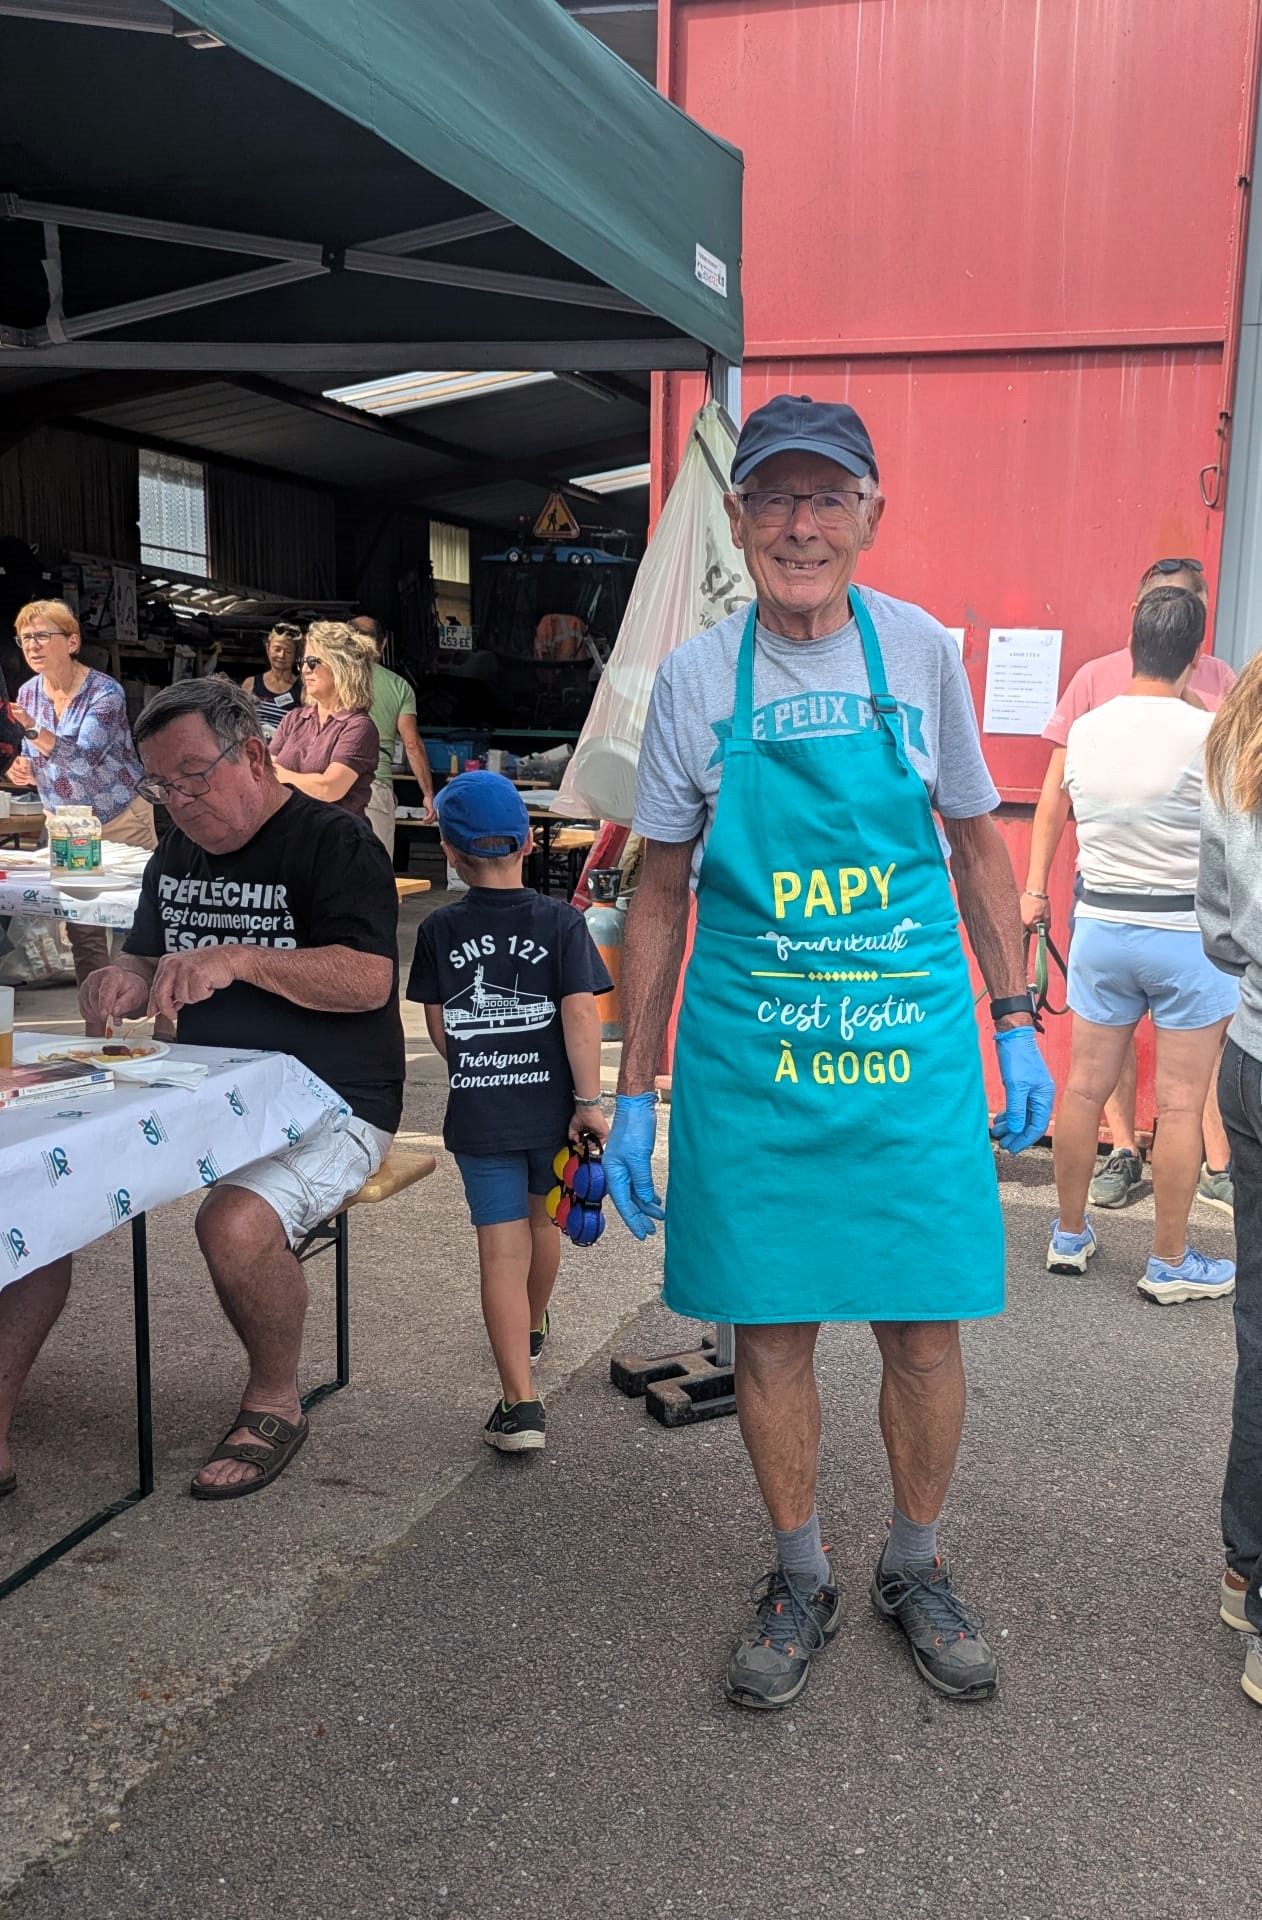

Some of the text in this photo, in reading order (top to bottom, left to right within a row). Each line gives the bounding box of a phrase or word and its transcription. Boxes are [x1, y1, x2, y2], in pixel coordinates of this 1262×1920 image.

[753, 712, 767, 740] E
[774, 696, 849, 734] PEUX
[158, 871, 288, 910] RÉFLÉCHIR
[772, 862, 896, 919] PAPY
[160, 901, 295, 931] 'est commencer à
[449, 934, 549, 969] SNS 127
[757, 994, 926, 1041] c'est festin
[450, 1070, 550, 1089] Concarneau
[458, 1051, 540, 1069] Trévignon
[774, 1039, 911, 1085] À GOGO
